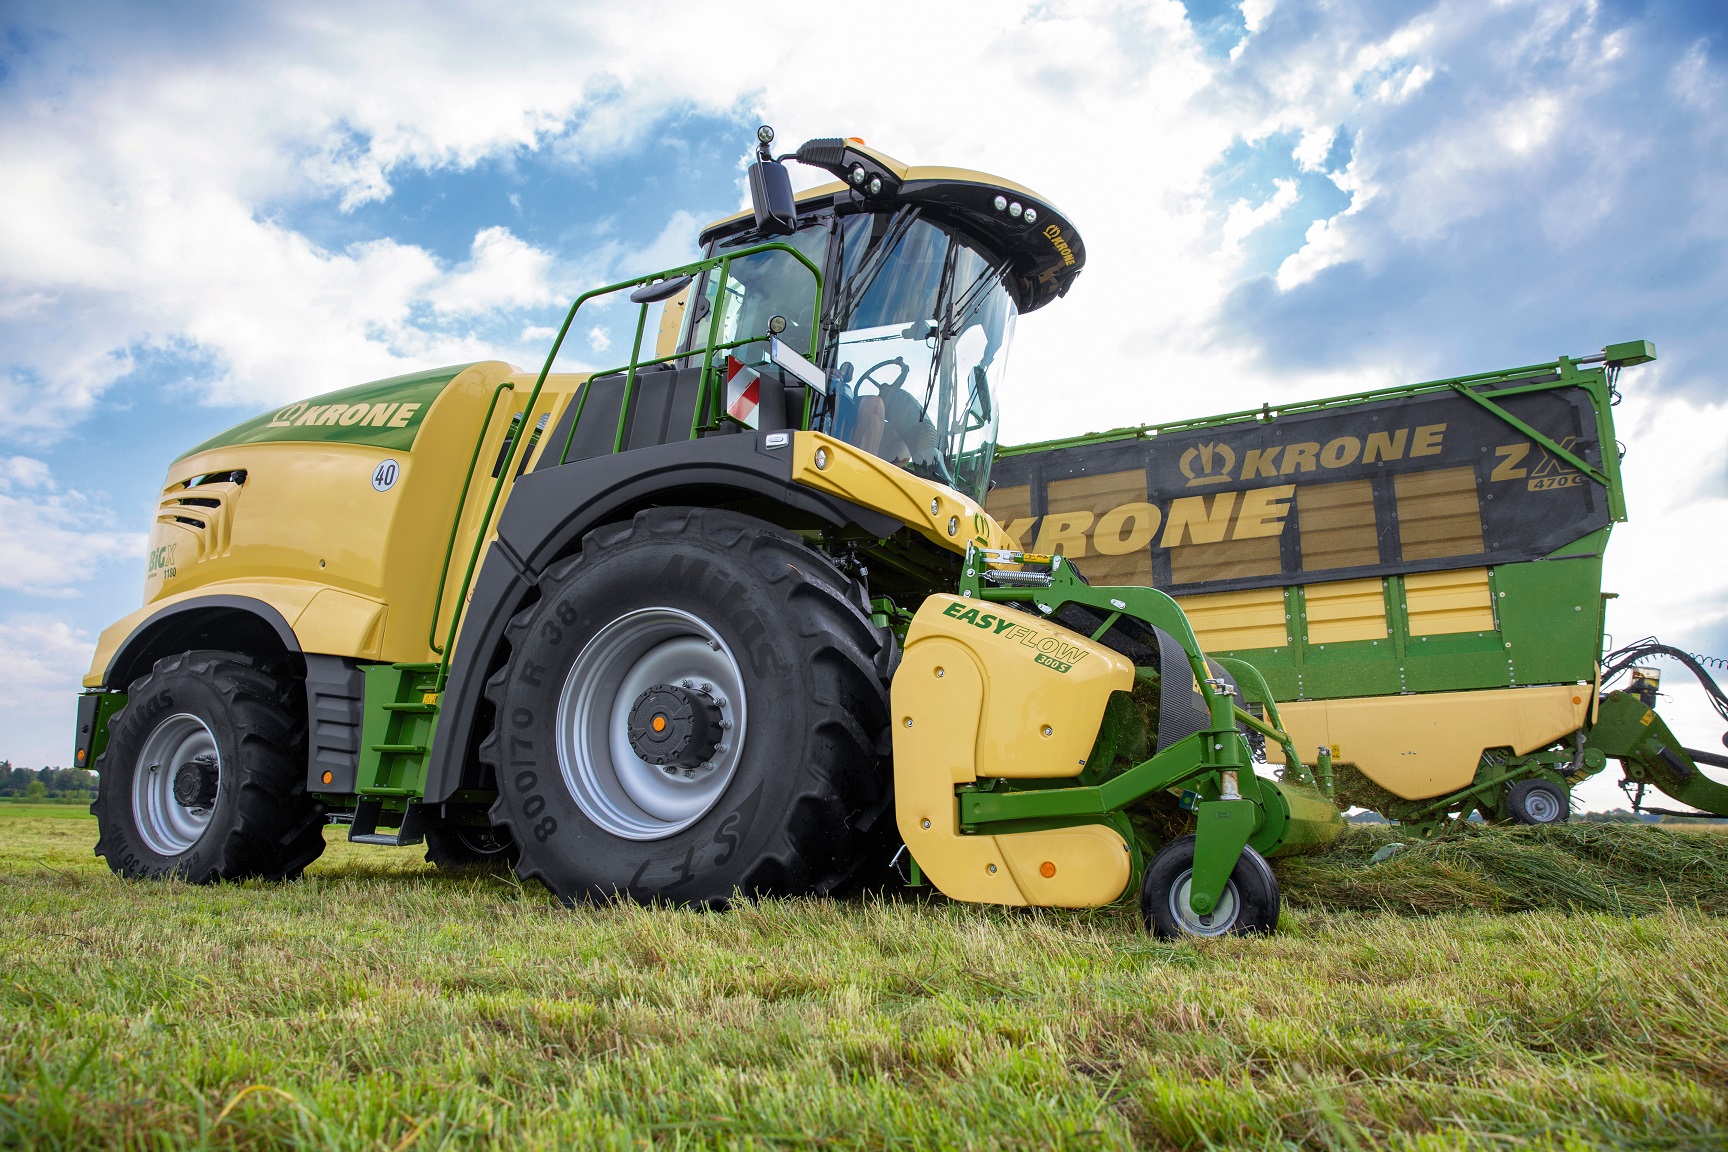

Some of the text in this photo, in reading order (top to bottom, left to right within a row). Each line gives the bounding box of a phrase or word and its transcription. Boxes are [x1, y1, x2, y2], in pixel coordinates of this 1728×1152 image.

[1050, 236, 1076, 267] KRONE
[293, 402, 422, 428] KRONE
[1239, 422, 1448, 481] KRONE
[374, 464, 396, 486] 40
[1533, 476, 1569, 489] 470
[519, 658, 547, 688] R
[541, 599, 578, 647] 38
[942, 601, 1090, 665] EASYFLOW
[1037, 655, 1068, 672] 300 S
[123, 852, 140, 872] 30
